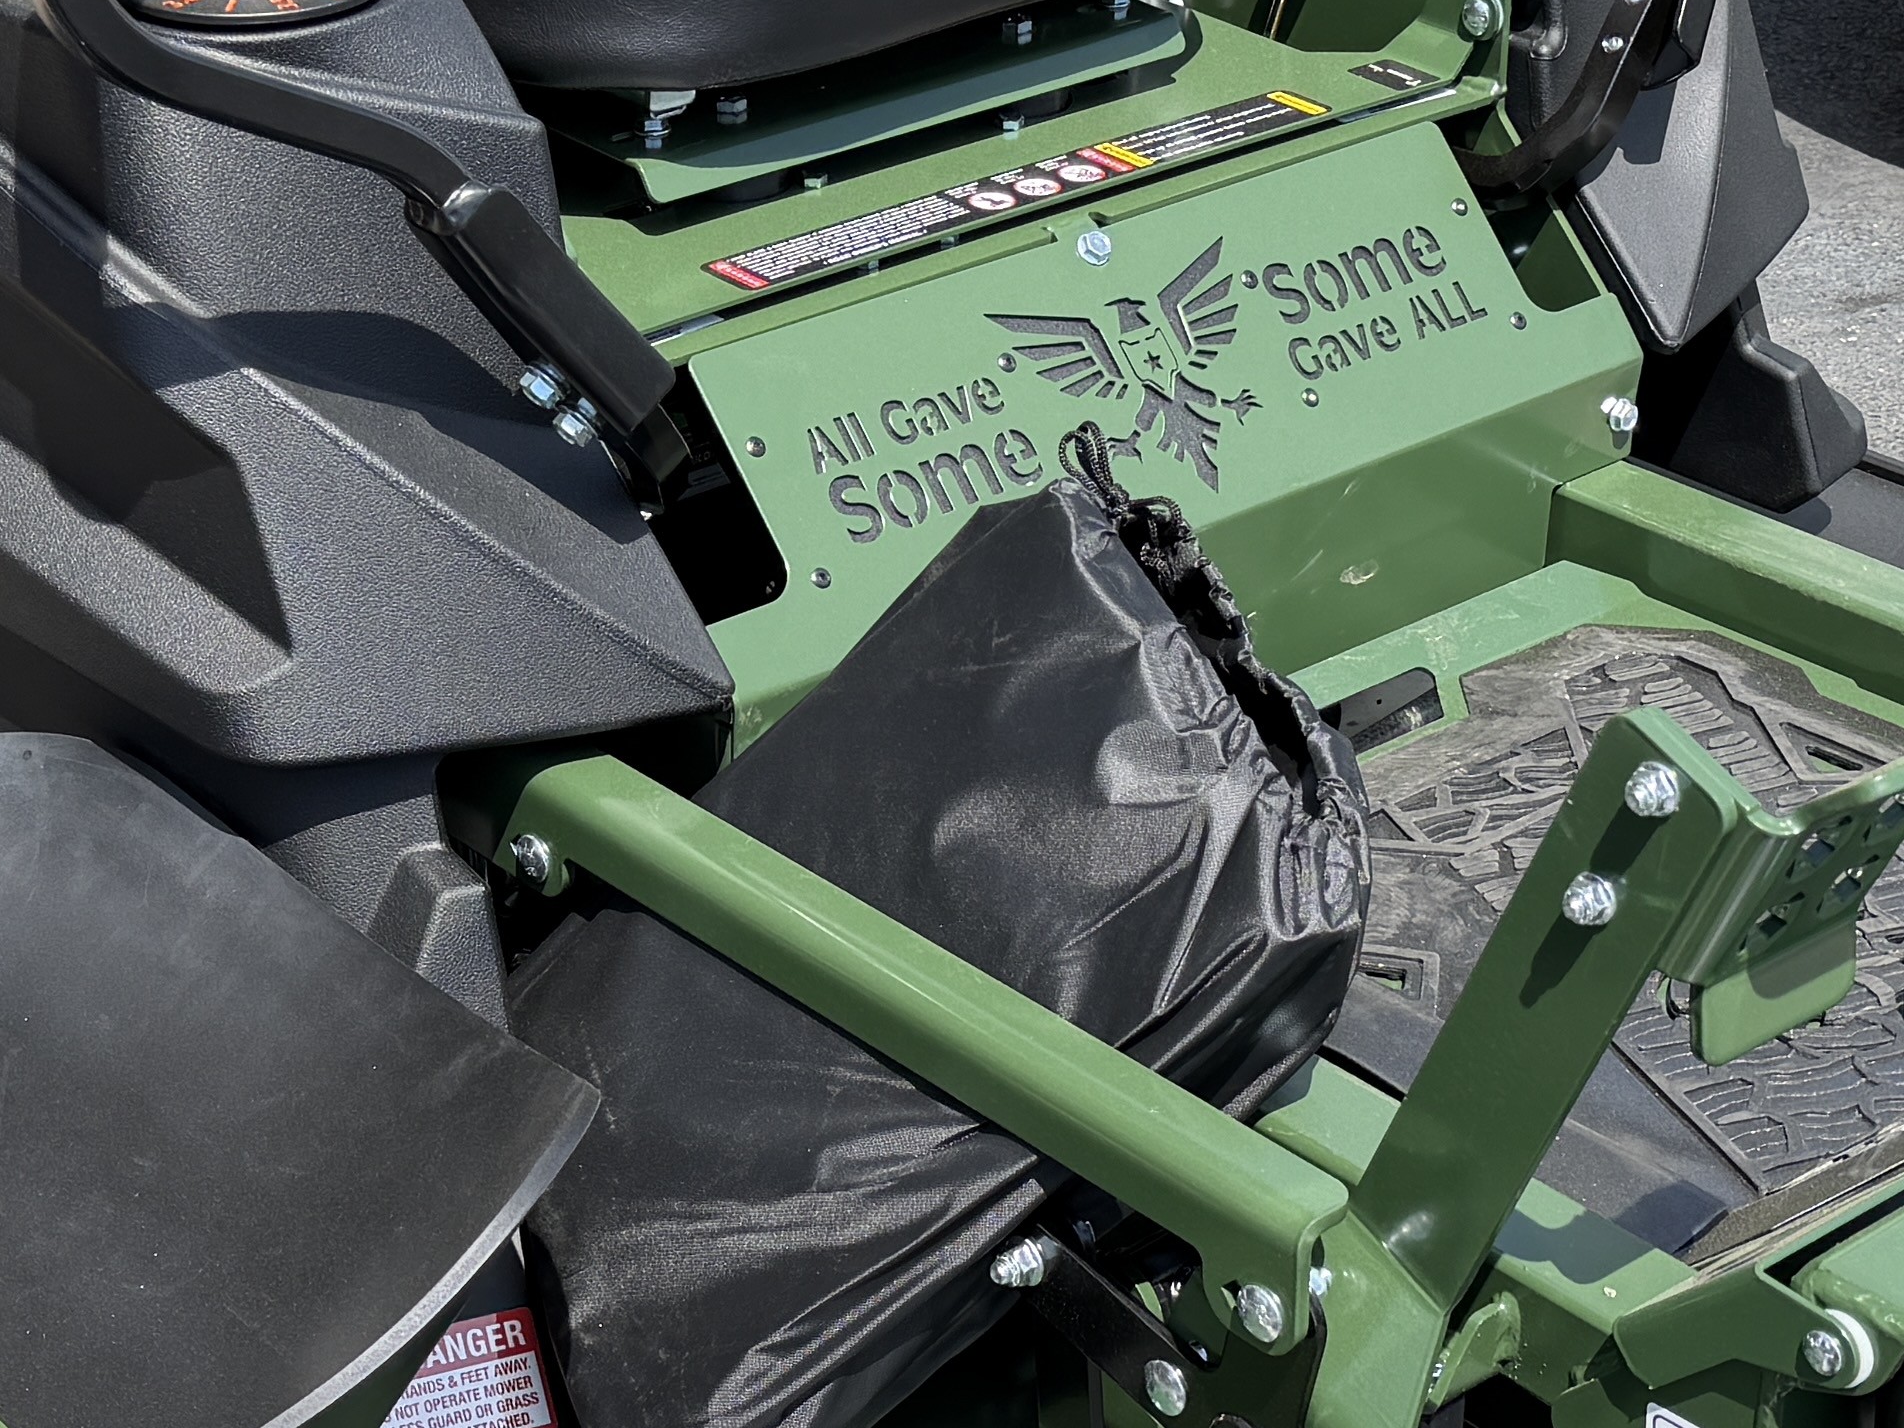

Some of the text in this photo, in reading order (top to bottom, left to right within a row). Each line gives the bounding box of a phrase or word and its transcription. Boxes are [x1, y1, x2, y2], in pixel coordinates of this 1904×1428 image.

[1261, 225, 1447, 325] Some
[1287, 280, 1489, 381] Gave ALL
[807, 377, 1006, 475] All Gave
[828, 428, 1044, 544] Some
[426, 1319, 527, 1369] ANGER
[447, 1375, 458, 1387] &
[460, 1365, 490, 1386] FEET
[493, 1356, 532, 1378] AWAY.
[395, 1375, 534, 1421] NOT OPERATE MOWER
[475, 1404, 494, 1419] OR
[496, 1391, 540, 1414] GRASS
